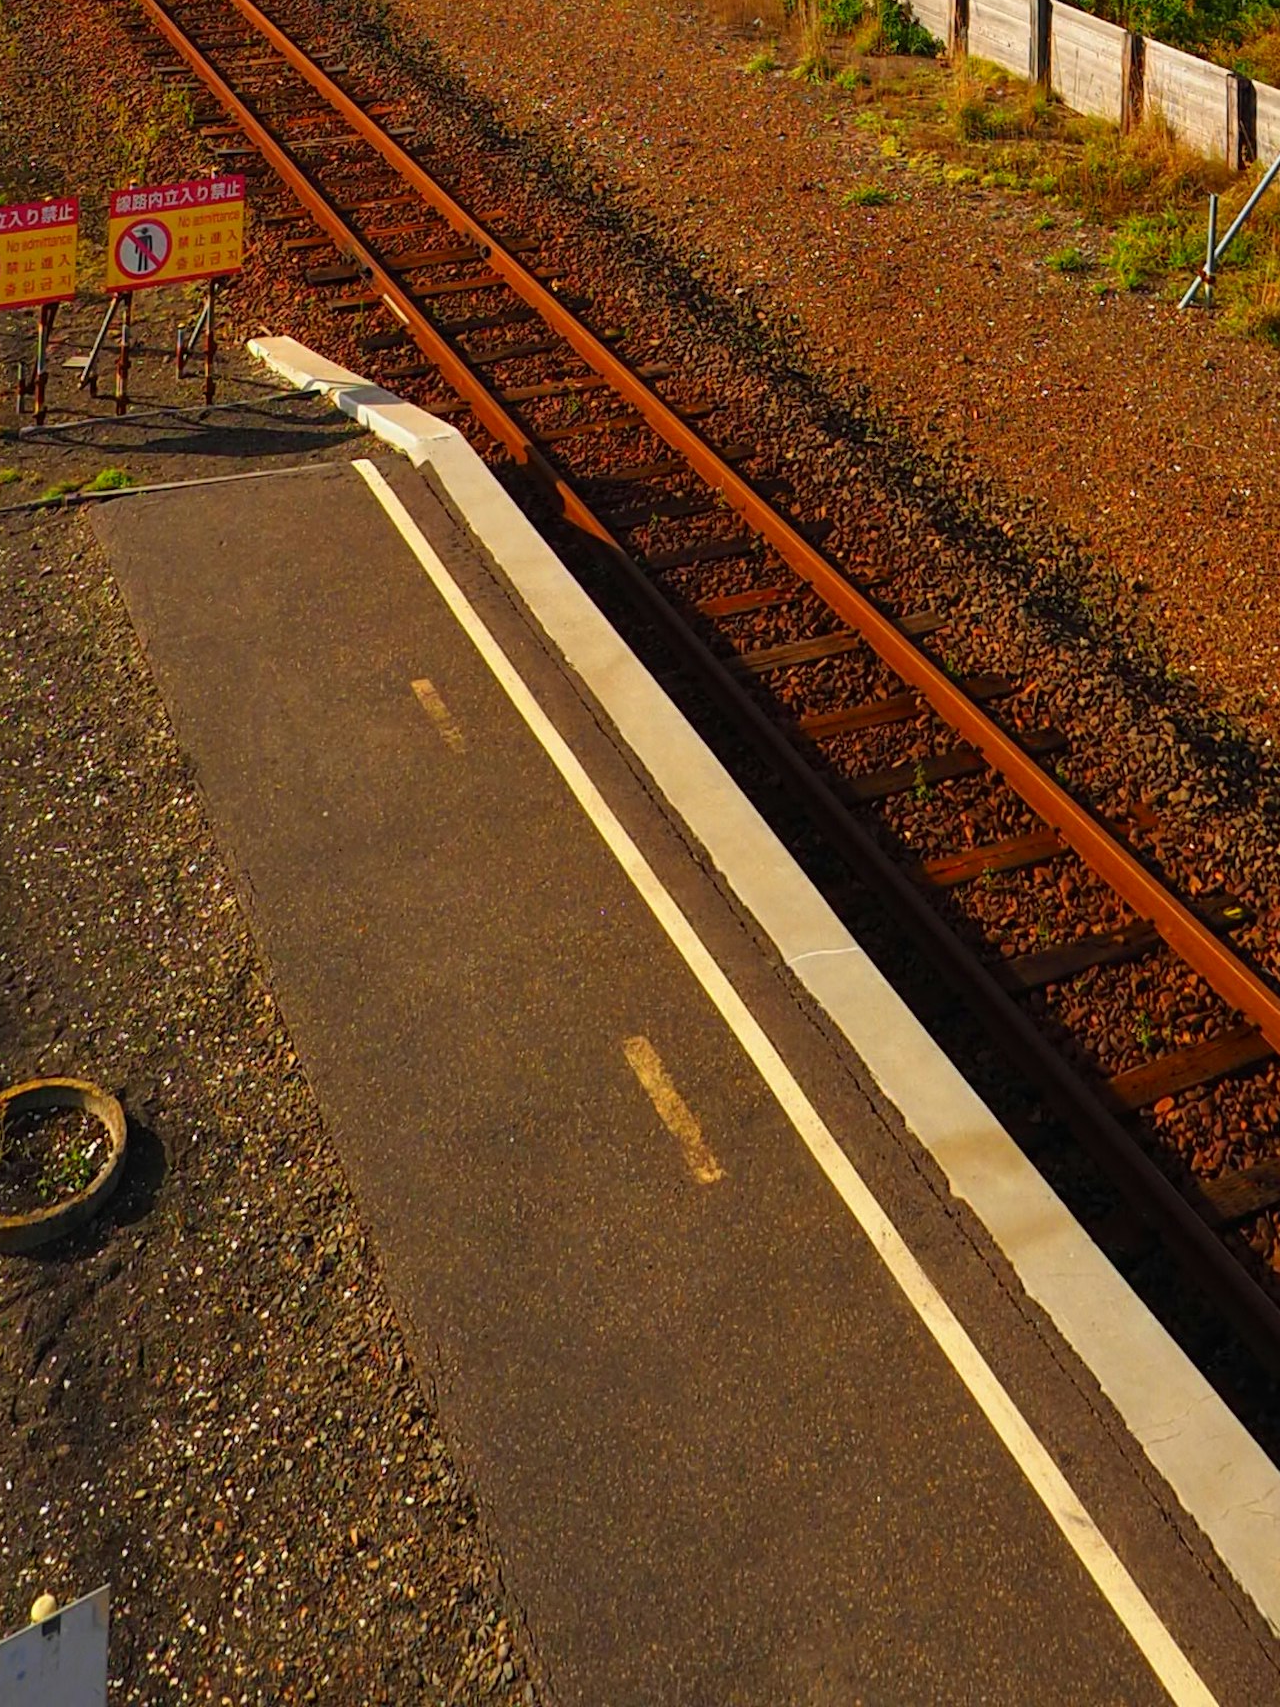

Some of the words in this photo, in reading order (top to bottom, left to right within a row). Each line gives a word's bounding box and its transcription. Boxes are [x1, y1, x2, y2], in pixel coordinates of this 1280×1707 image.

[115, 181, 241, 213] 線路内立入り禁止
[178, 215, 190, 228] No
[193, 210, 240, 226] admittance
[6, 240, 19, 253] No
[22, 235, 73, 250] admittance
